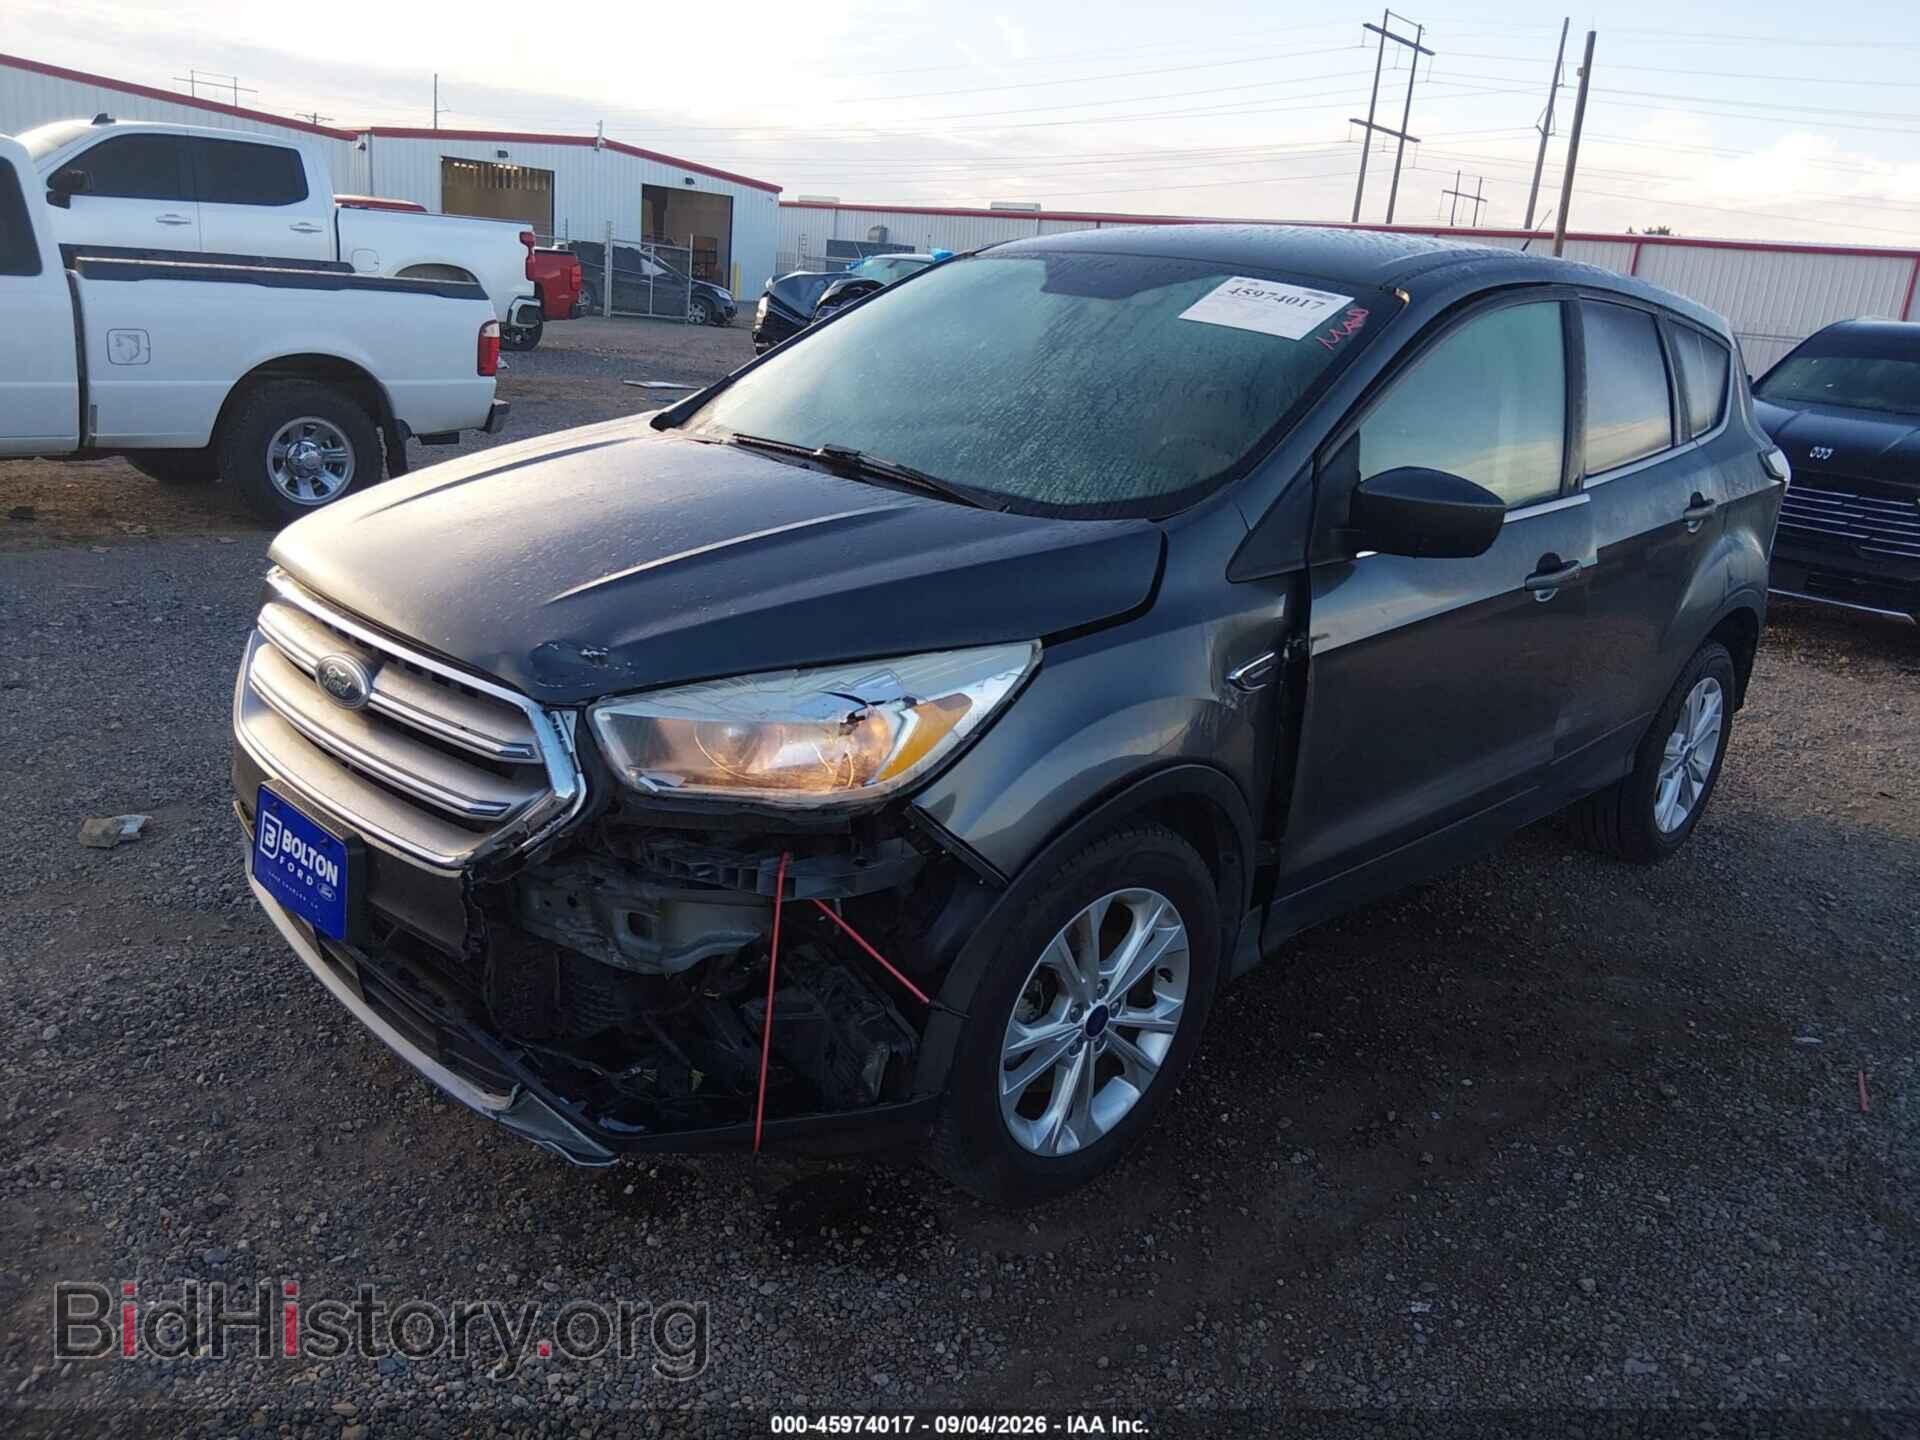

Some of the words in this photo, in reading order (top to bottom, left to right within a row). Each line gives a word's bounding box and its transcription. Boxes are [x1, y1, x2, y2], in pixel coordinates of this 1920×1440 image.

[1227, 286, 1326, 310] 45974017
[279, 855, 314, 886] FORD
[281, 829, 339, 887] BOLTON
